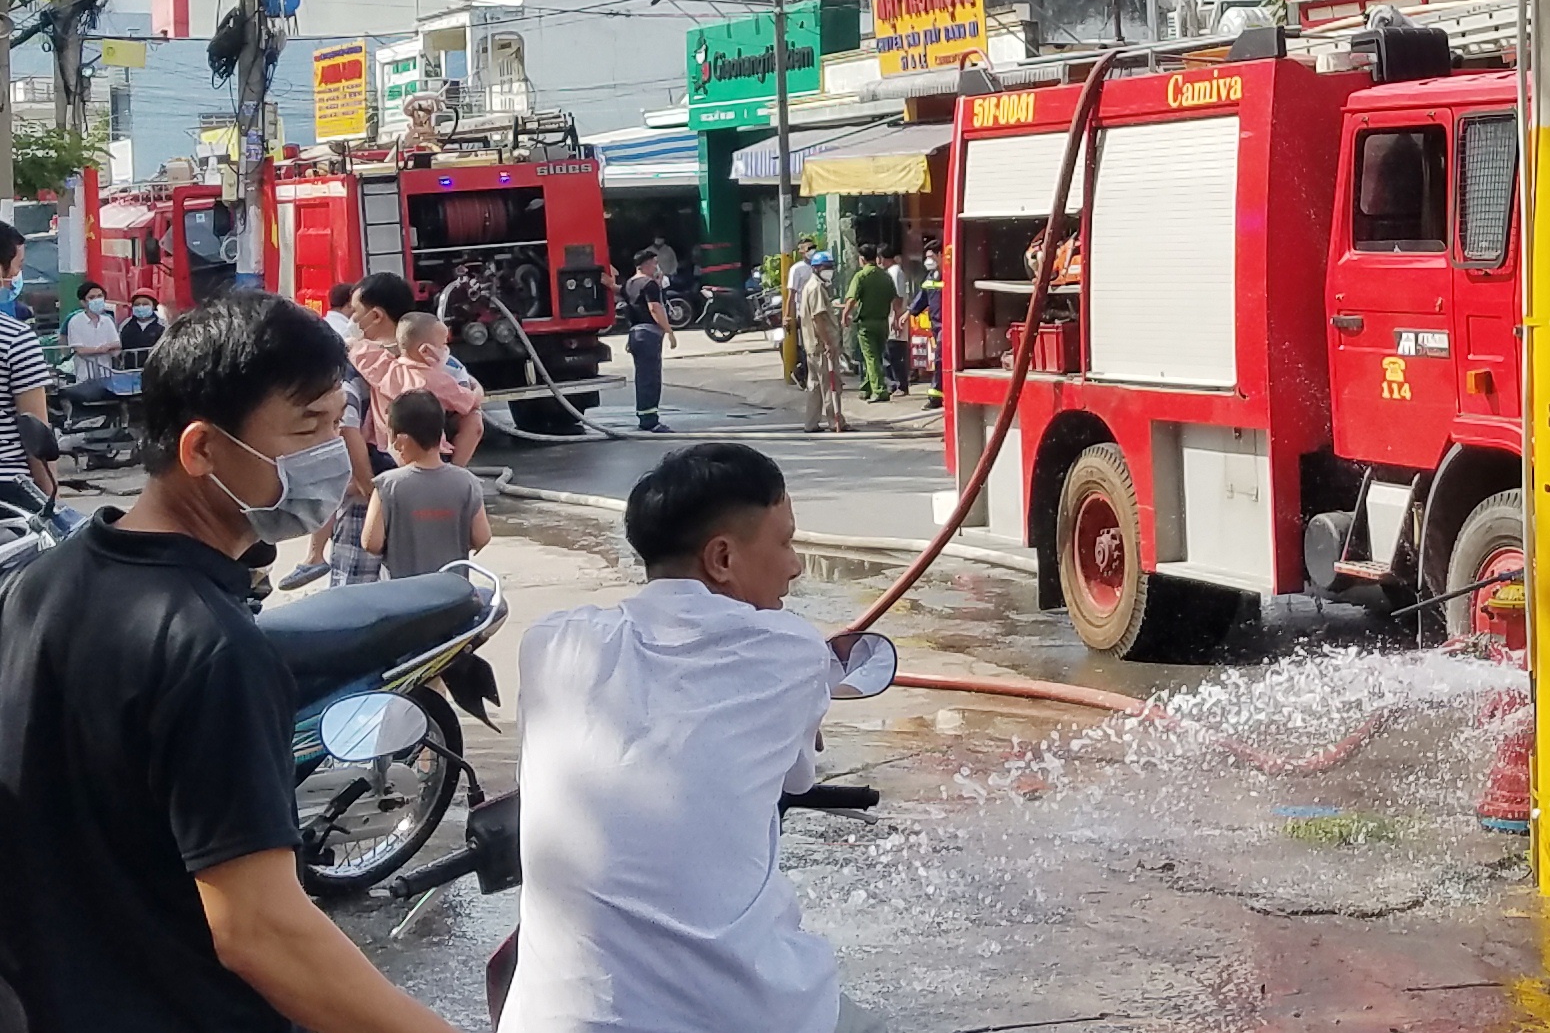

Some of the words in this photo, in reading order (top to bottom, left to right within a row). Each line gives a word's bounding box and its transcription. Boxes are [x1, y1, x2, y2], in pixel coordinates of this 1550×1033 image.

[1167, 69, 1242, 108] Camiva
[973, 92, 1035, 128] 51F-0041
[1381, 380, 1412, 401] 114
